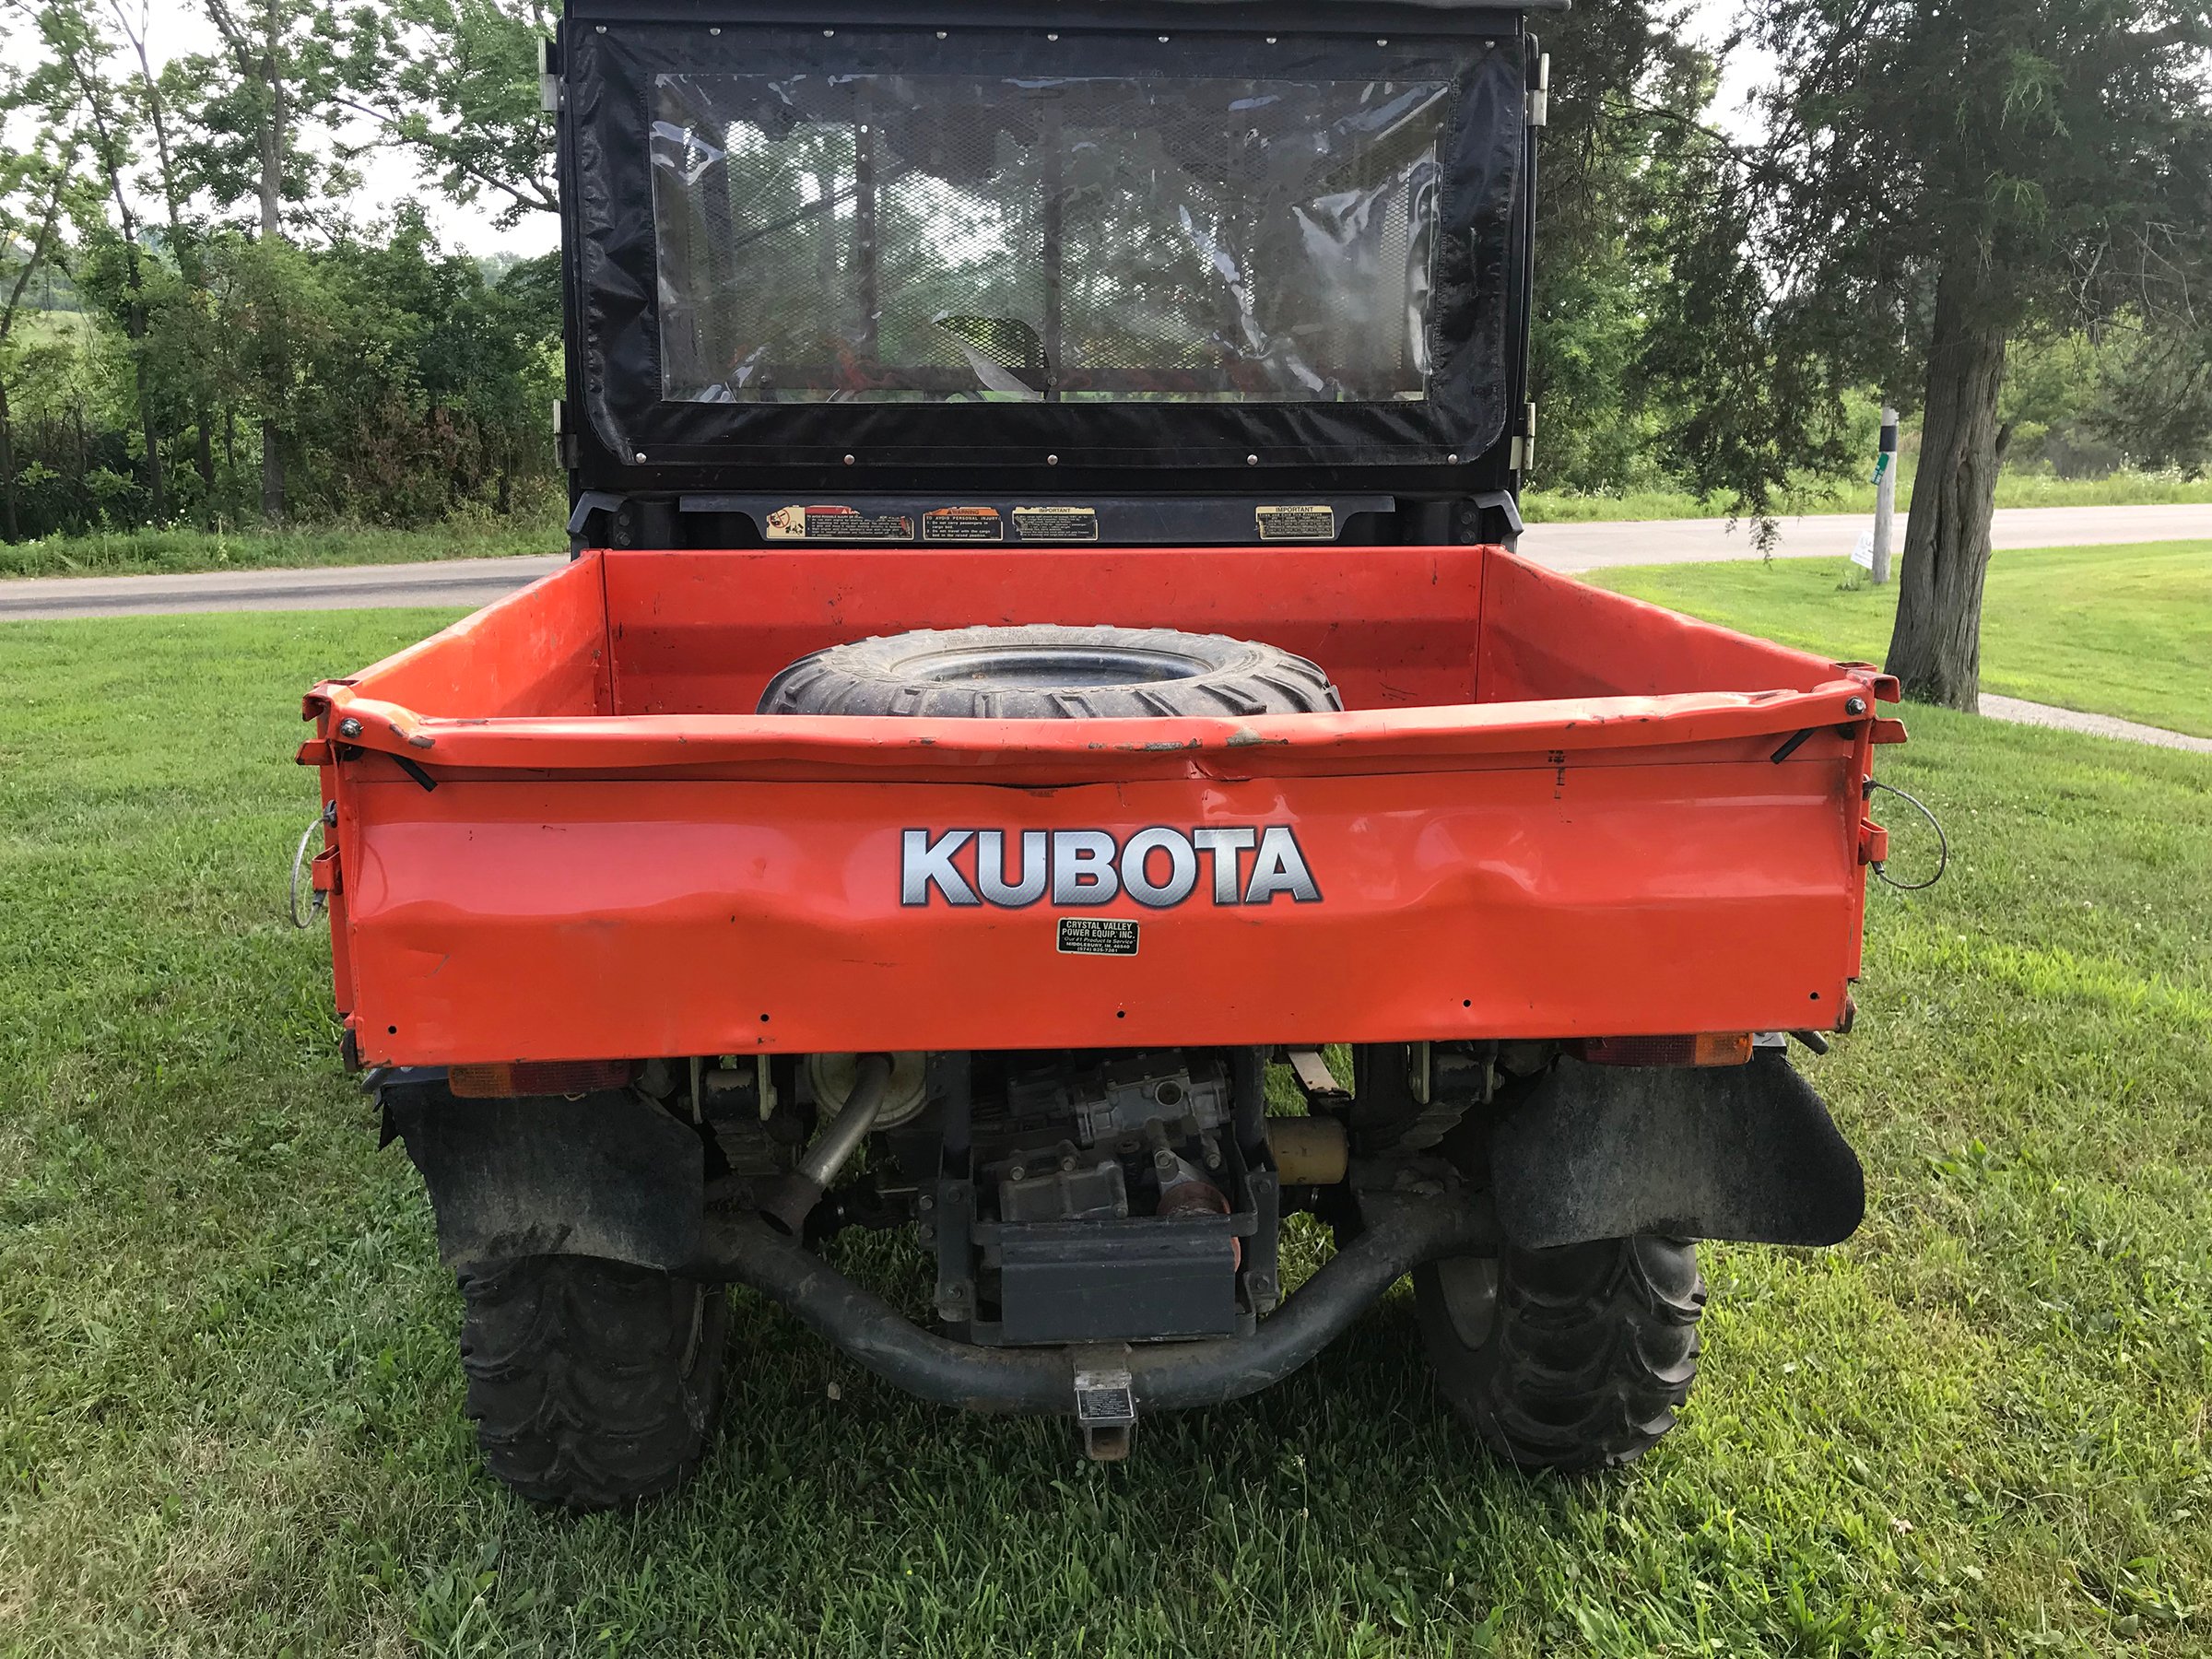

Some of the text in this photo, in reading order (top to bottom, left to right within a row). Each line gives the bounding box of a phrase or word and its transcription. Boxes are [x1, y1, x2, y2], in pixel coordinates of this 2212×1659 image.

[899, 825, 1322, 908] KUBOTA
[1066, 921, 1132, 931] CRYSTAL VALLEY
[1062, 928, 1135, 939] POWER EQUIP. INC.
